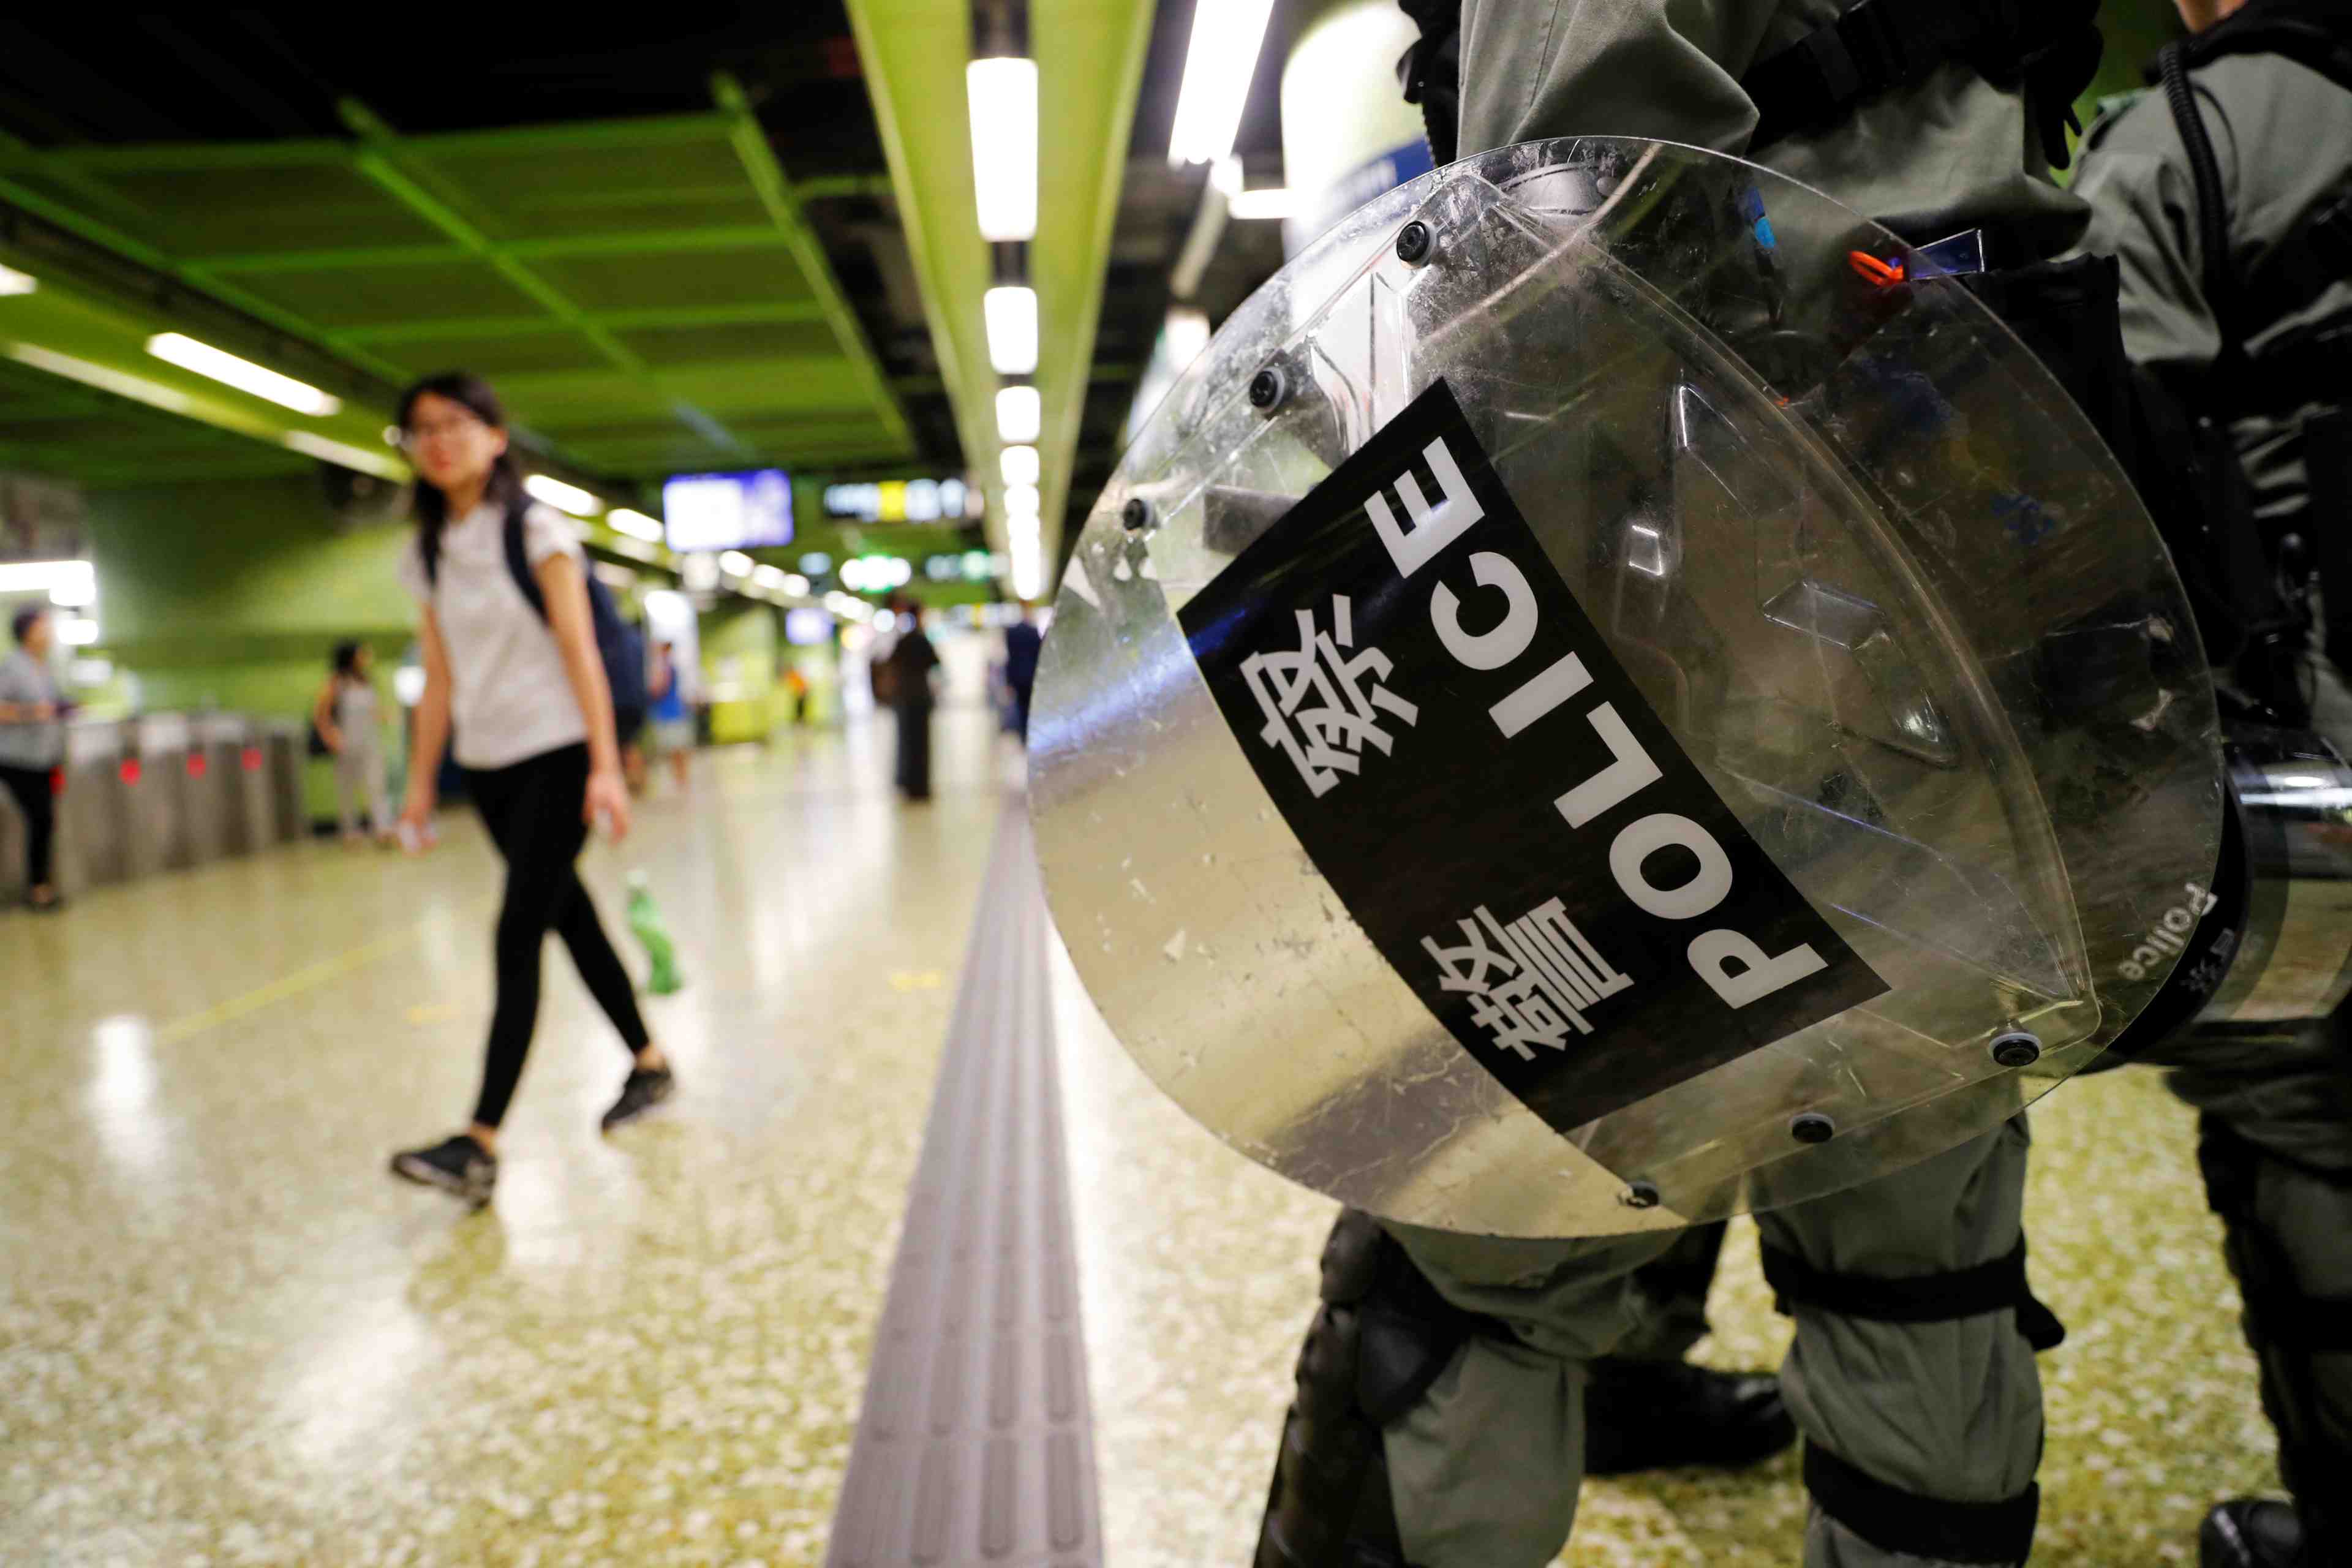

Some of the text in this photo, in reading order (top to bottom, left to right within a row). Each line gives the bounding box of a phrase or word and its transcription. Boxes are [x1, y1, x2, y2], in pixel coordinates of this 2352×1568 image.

[1238, 593, 1635, 1062] 警察
[1363, 435, 1828, 1009] POLICE
[2117, 882, 2218, 981] Police
